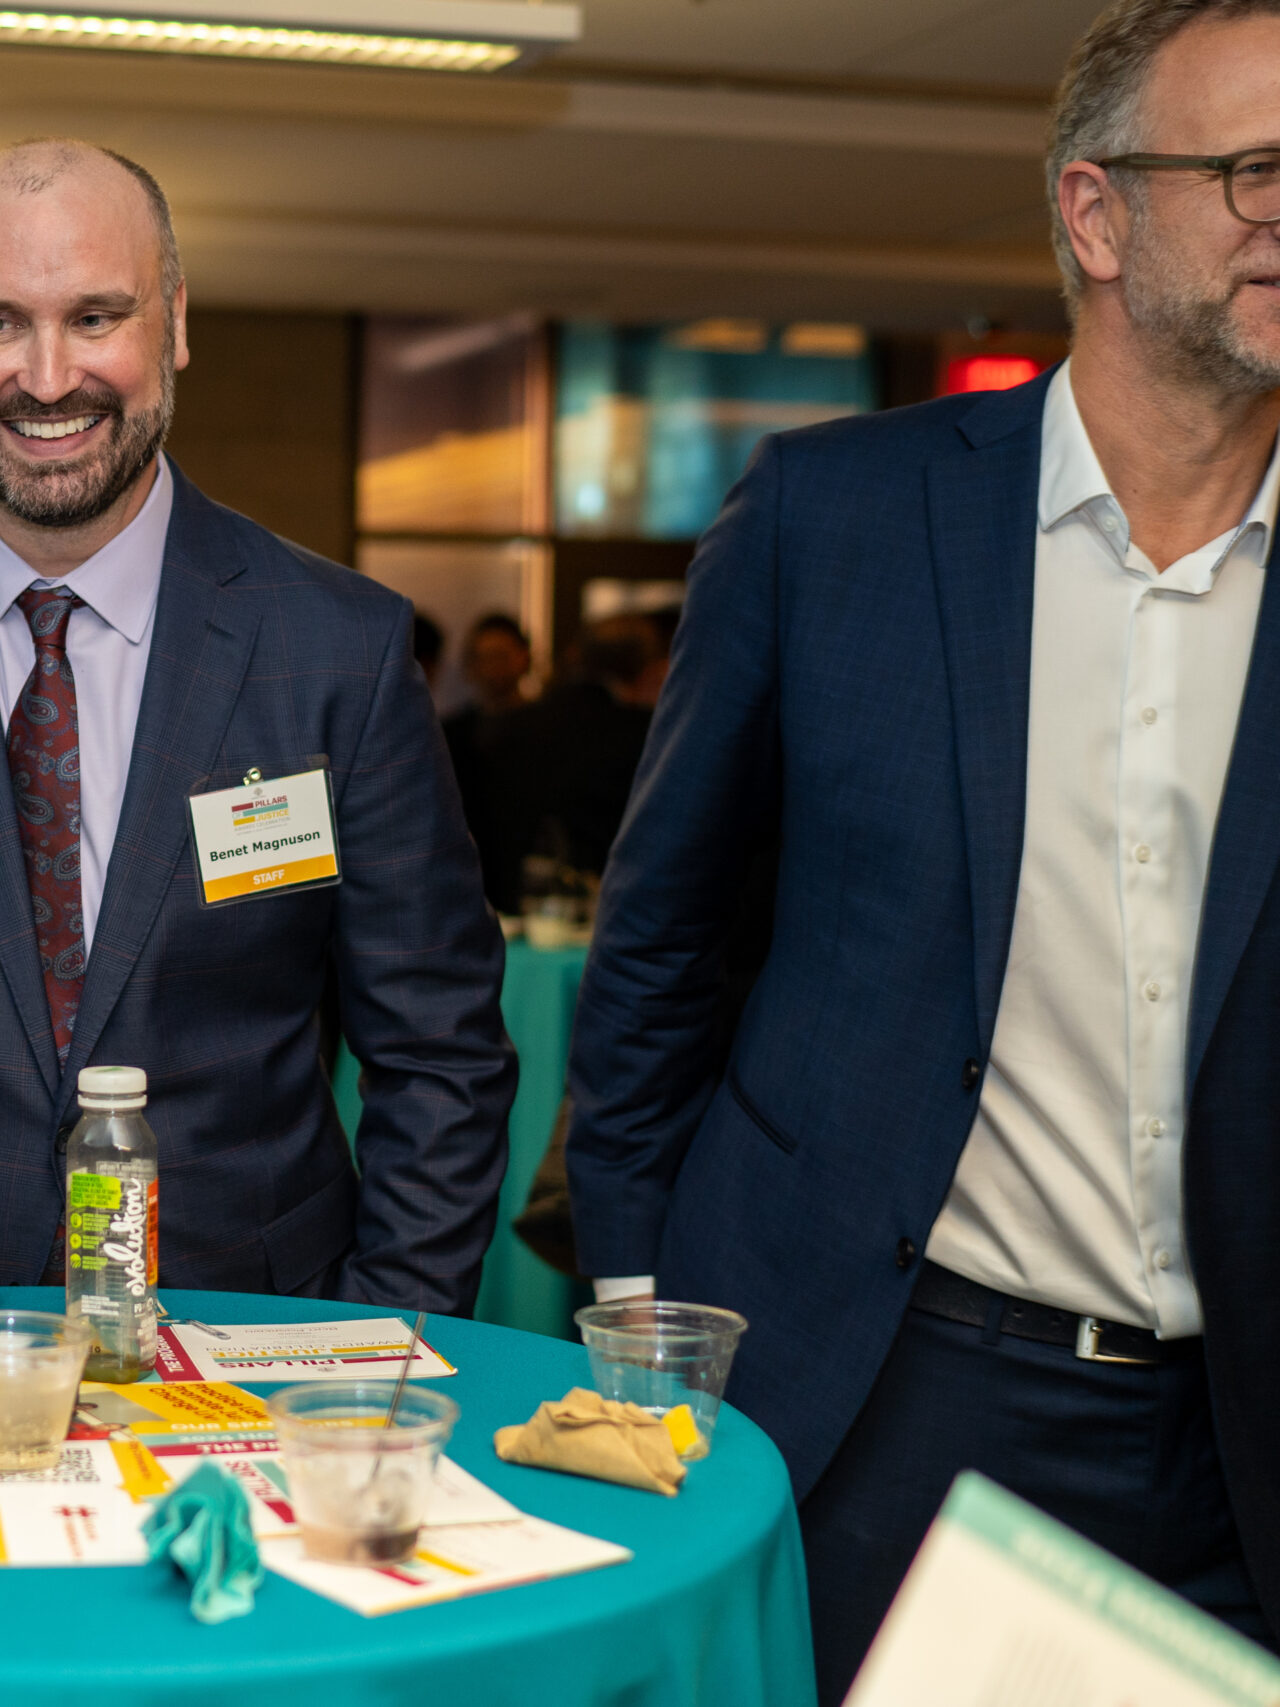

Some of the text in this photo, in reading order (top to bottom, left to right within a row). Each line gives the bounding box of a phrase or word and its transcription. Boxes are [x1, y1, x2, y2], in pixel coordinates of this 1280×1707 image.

[255, 795, 288, 808] PILLARS
[255, 809, 289, 821] JUSTICE
[210, 830, 321, 862] Benet Magnuson
[253, 869, 285, 885] STAFF
[103, 1178, 146, 1296] evolution
[205, 1343, 326, 1352] CELEBRATION
[331, 1339, 404, 1348] AWARDS
[208, 1347, 327, 1358] JUSTICE
[219, 1358, 337, 1369] PILLARS
[149, 1387, 200, 1411] Change
[169, 1385, 225, 1410] Promote
[190, 1383, 243, 1408] Practice
[170, 1422, 221, 1431] OUR
[178, 1434, 234, 1443] 2024
[197, 1442, 248, 1453] THE
